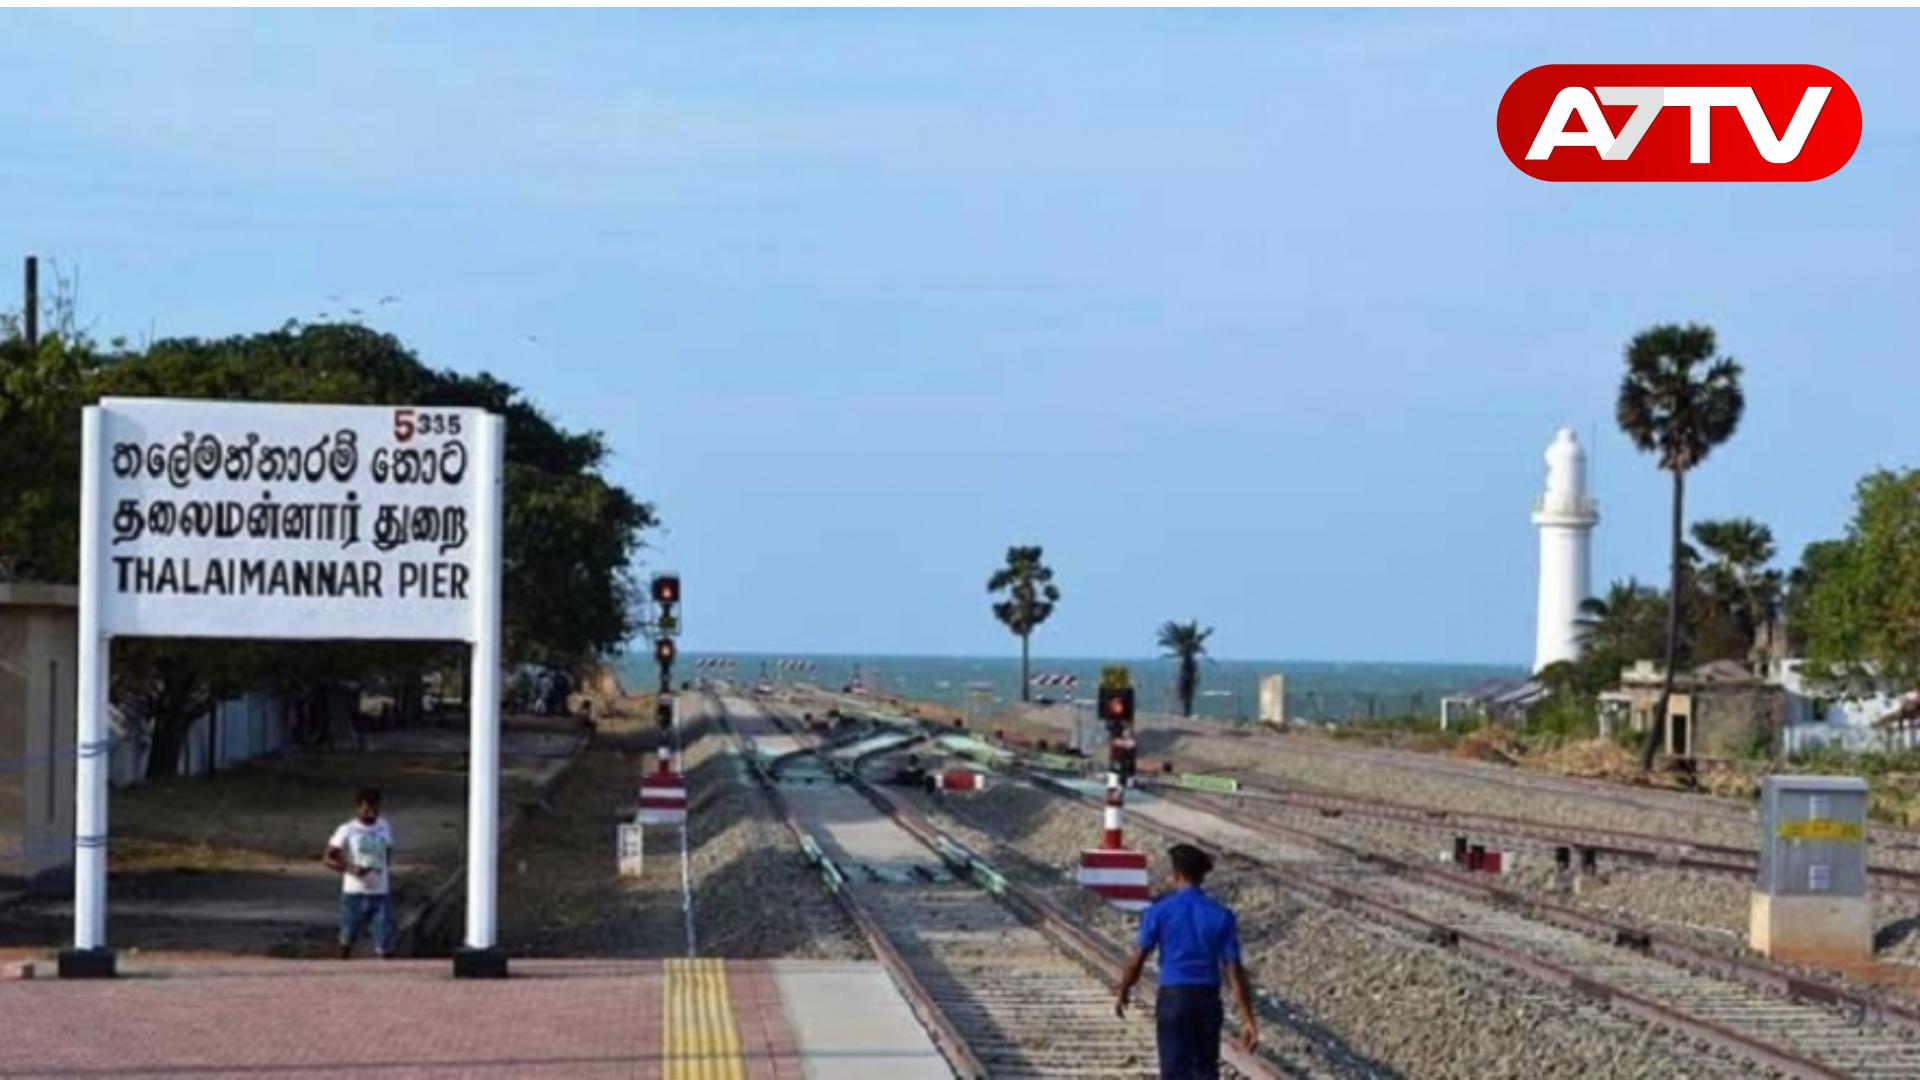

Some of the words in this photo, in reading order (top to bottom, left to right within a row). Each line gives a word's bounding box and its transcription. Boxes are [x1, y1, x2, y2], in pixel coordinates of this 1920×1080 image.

[371, 440, 467, 485] තොට
[112, 491, 362, 549] தலைமன்னார்
[373, 504, 469, 556] துறை
[112, 556, 384, 598] THALAIMANNAR
[398, 561, 470, 599] PIER
